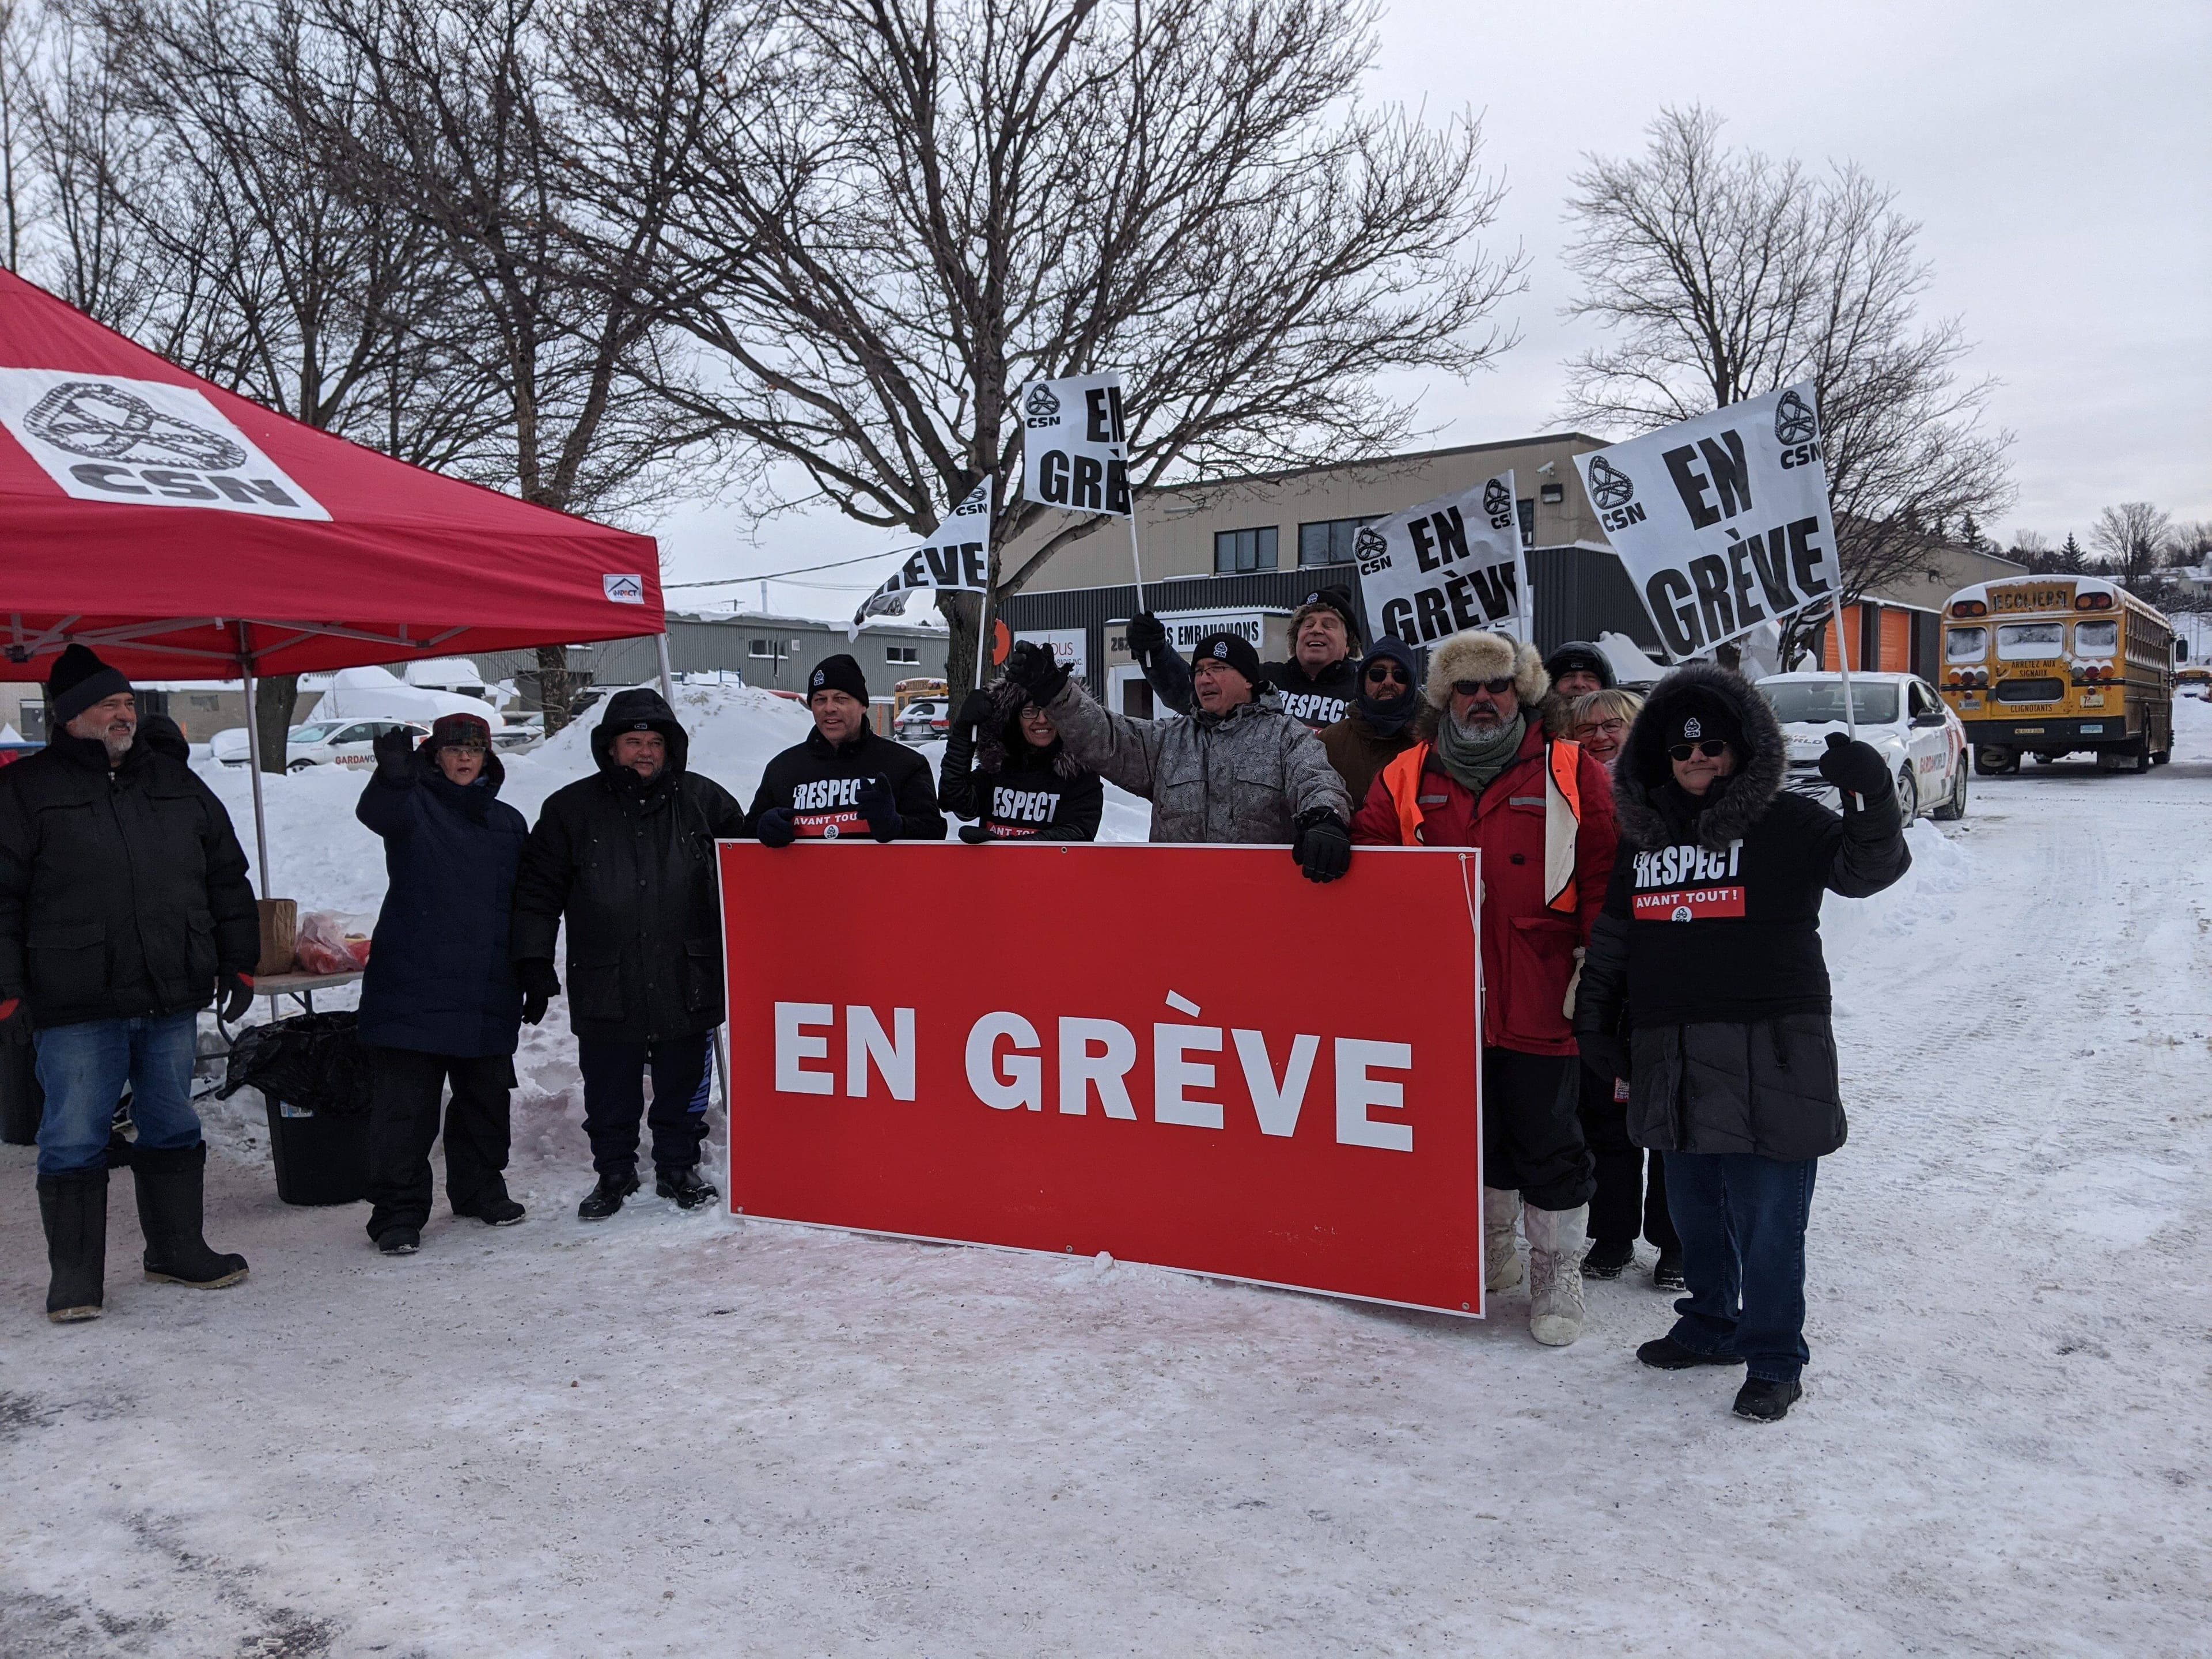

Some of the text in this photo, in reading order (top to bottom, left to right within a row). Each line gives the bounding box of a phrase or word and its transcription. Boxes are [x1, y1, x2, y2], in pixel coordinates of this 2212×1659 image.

[1027, 416, 1060, 429] CSN
[1781, 441, 1823, 469] CSN
[69, 463, 300, 508] CSN
[1662, 429, 1752, 531] EN
[955, 503, 987, 516] CSN
[1491, 513, 1515, 529] CS
[1601, 502, 1647, 532] CSN
[1407, 506, 1469, 573] EN
[1361, 555, 1392, 575] CSN
[1646, 516, 1832, 656] GRÈVE
[2019, 669, 2047, 677] SIGNAUX
[2010, 704, 2052, 713] CLIGNOTANTS
[794, 778, 876, 810] RESPEC
[992, 786, 1060, 823] ESPECT
[794, 816, 831, 825] AVANT
[1635, 839, 1743, 888] RESPECT
[1637, 895, 1680, 908] AVANT
[774, 989, 1414, 1153] EN GRÈVE
